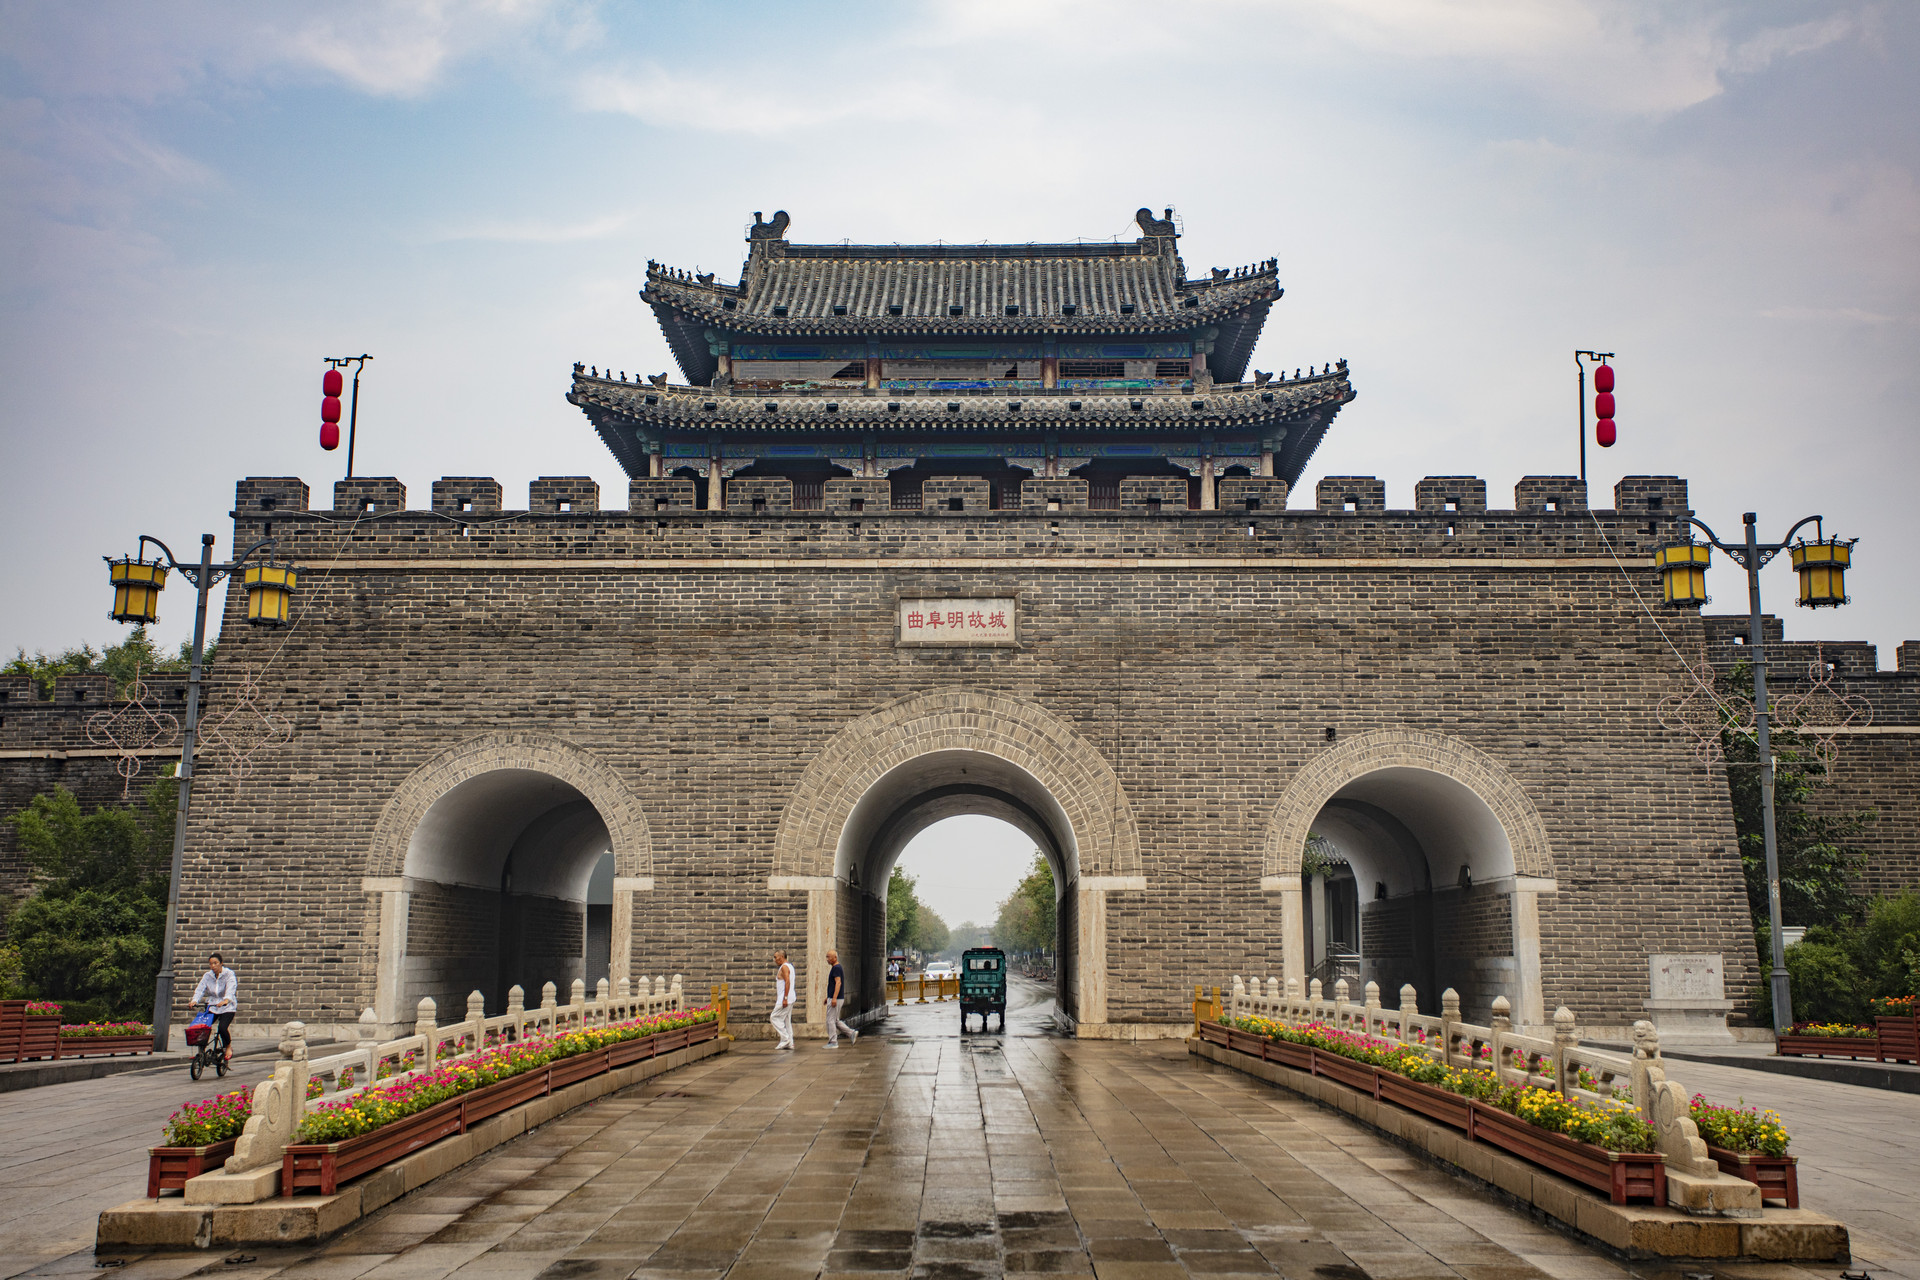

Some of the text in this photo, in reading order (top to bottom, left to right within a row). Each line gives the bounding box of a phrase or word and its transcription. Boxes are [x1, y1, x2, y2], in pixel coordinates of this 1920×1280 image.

[907, 610, 1008, 629] 曲阜明故城
